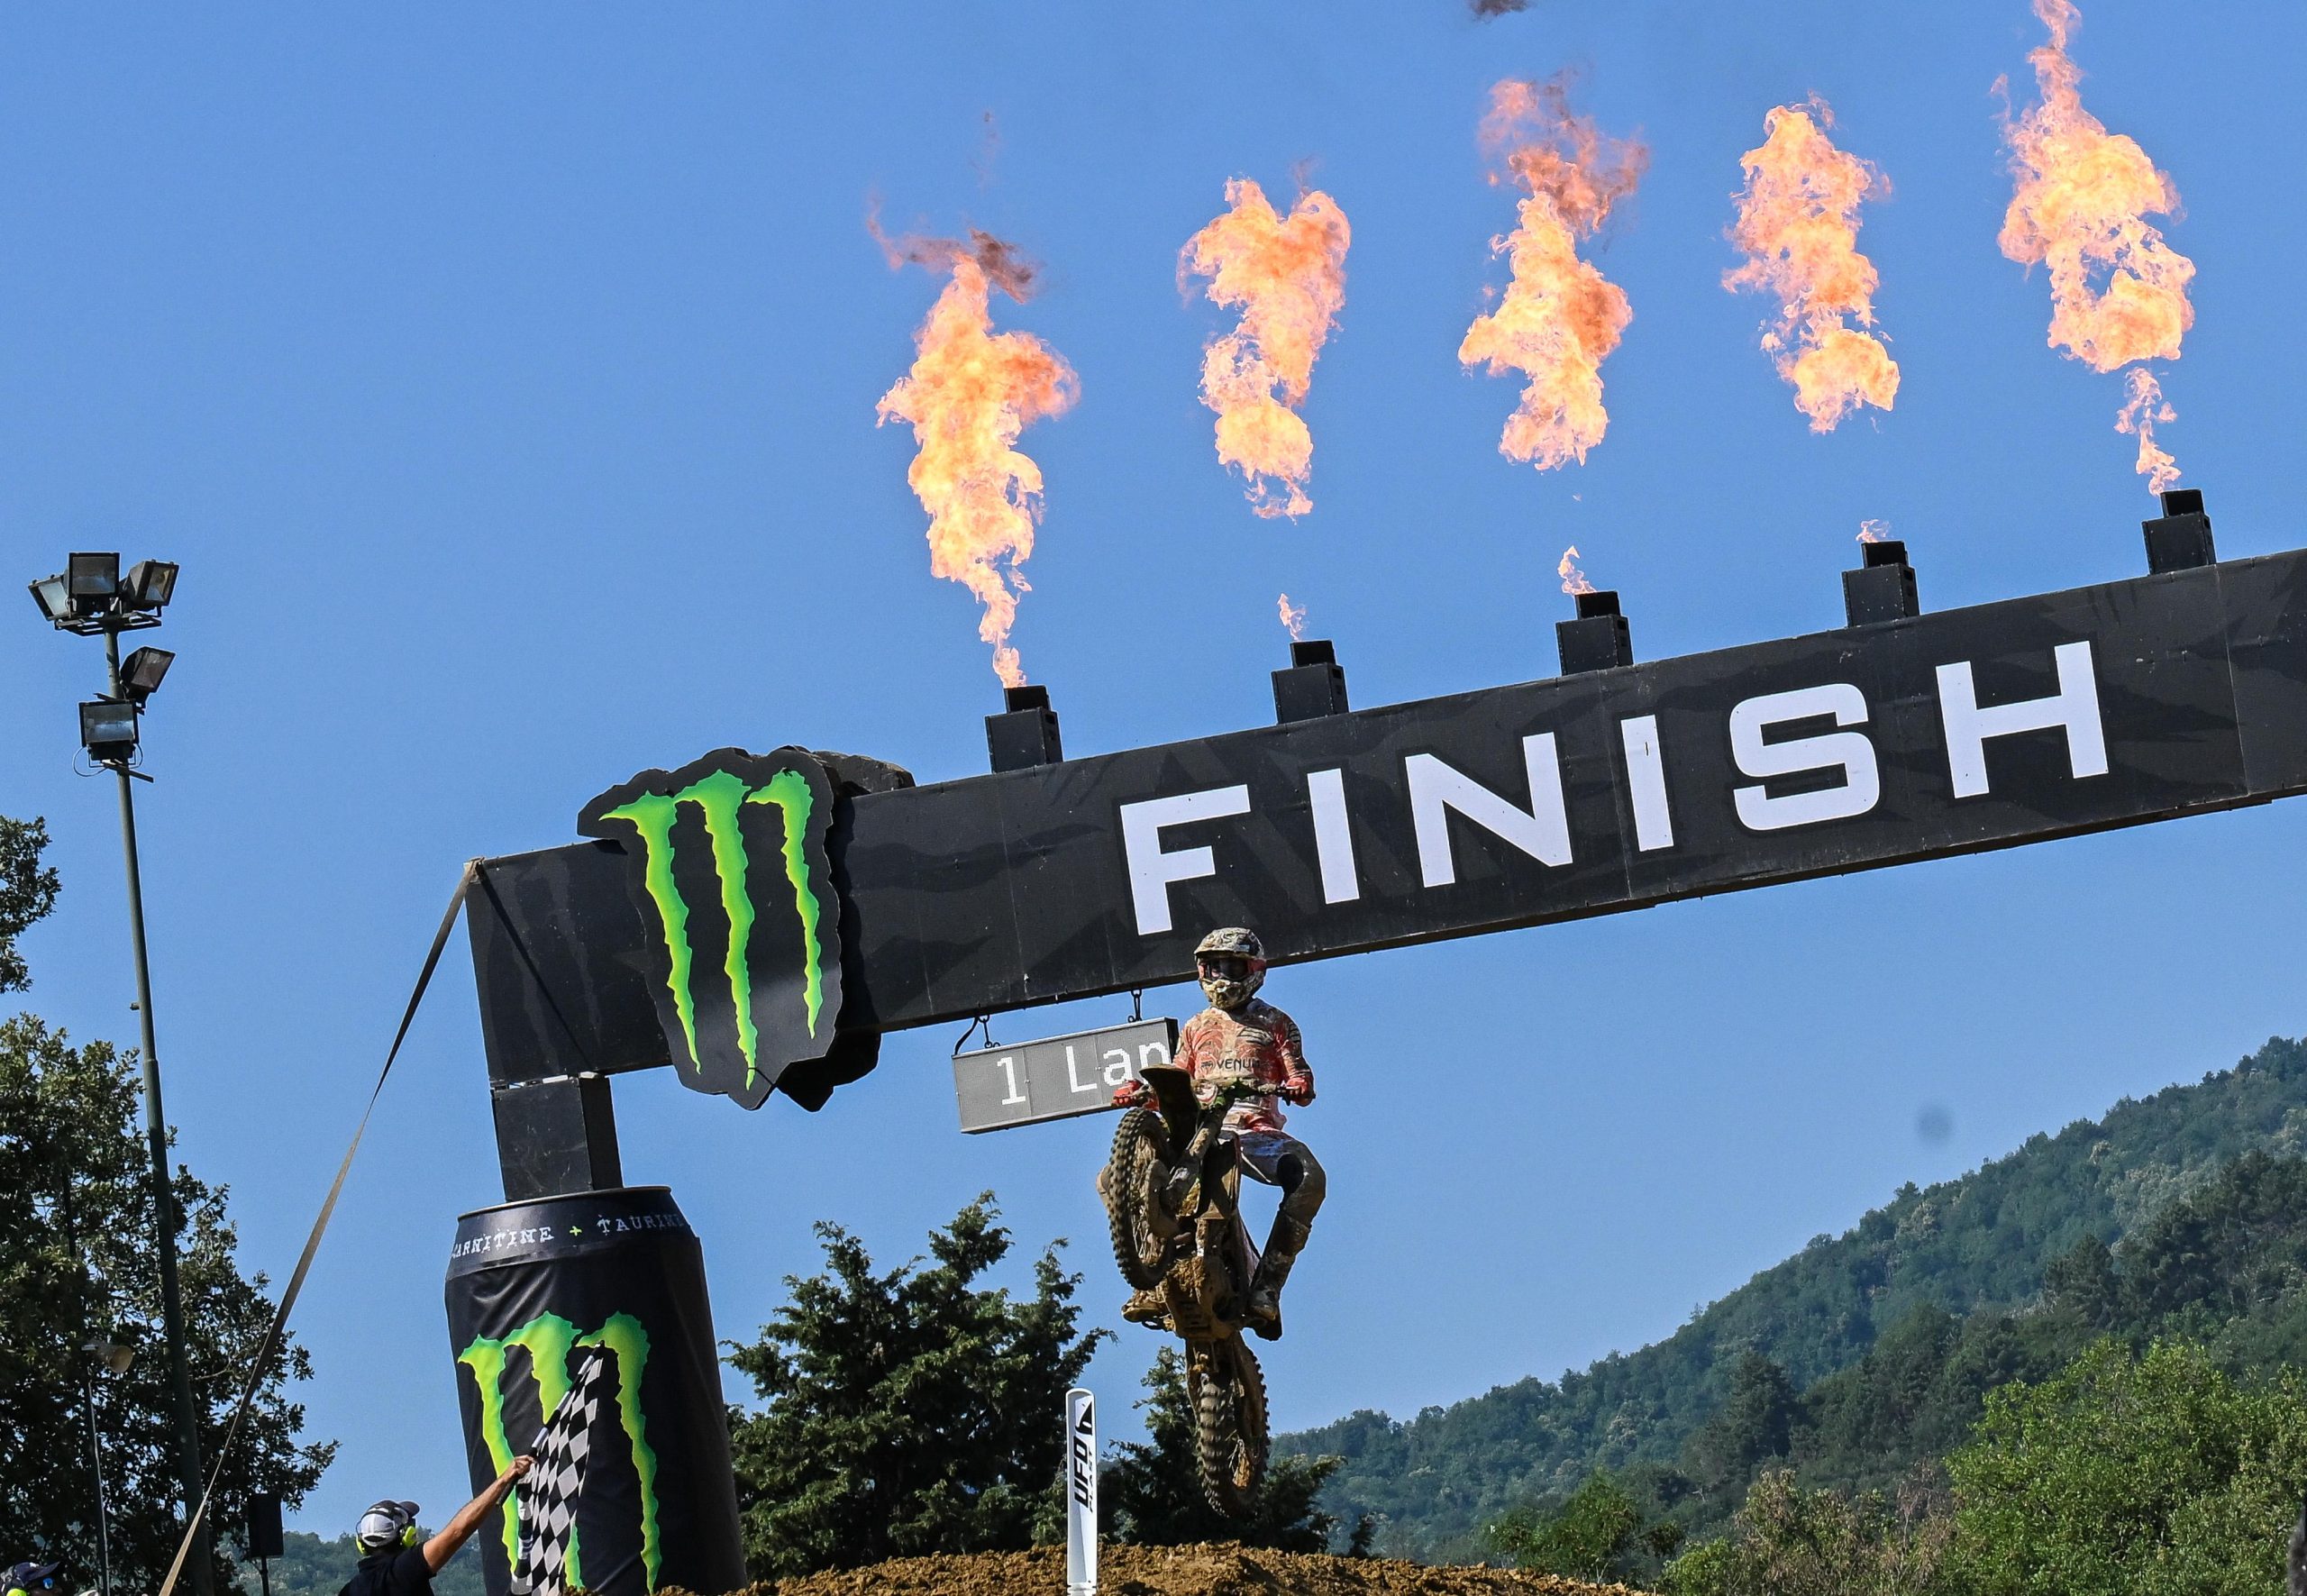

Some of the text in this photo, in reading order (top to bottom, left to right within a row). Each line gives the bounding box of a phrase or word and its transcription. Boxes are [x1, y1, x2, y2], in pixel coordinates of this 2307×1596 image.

[1119, 641, 2109, 935] FINISH
[997, 1056, 1026, 1106] 1
[1217, 1058, 1259, 1072] VENUM
[1073, 1436, 1089, 1508] UFO
